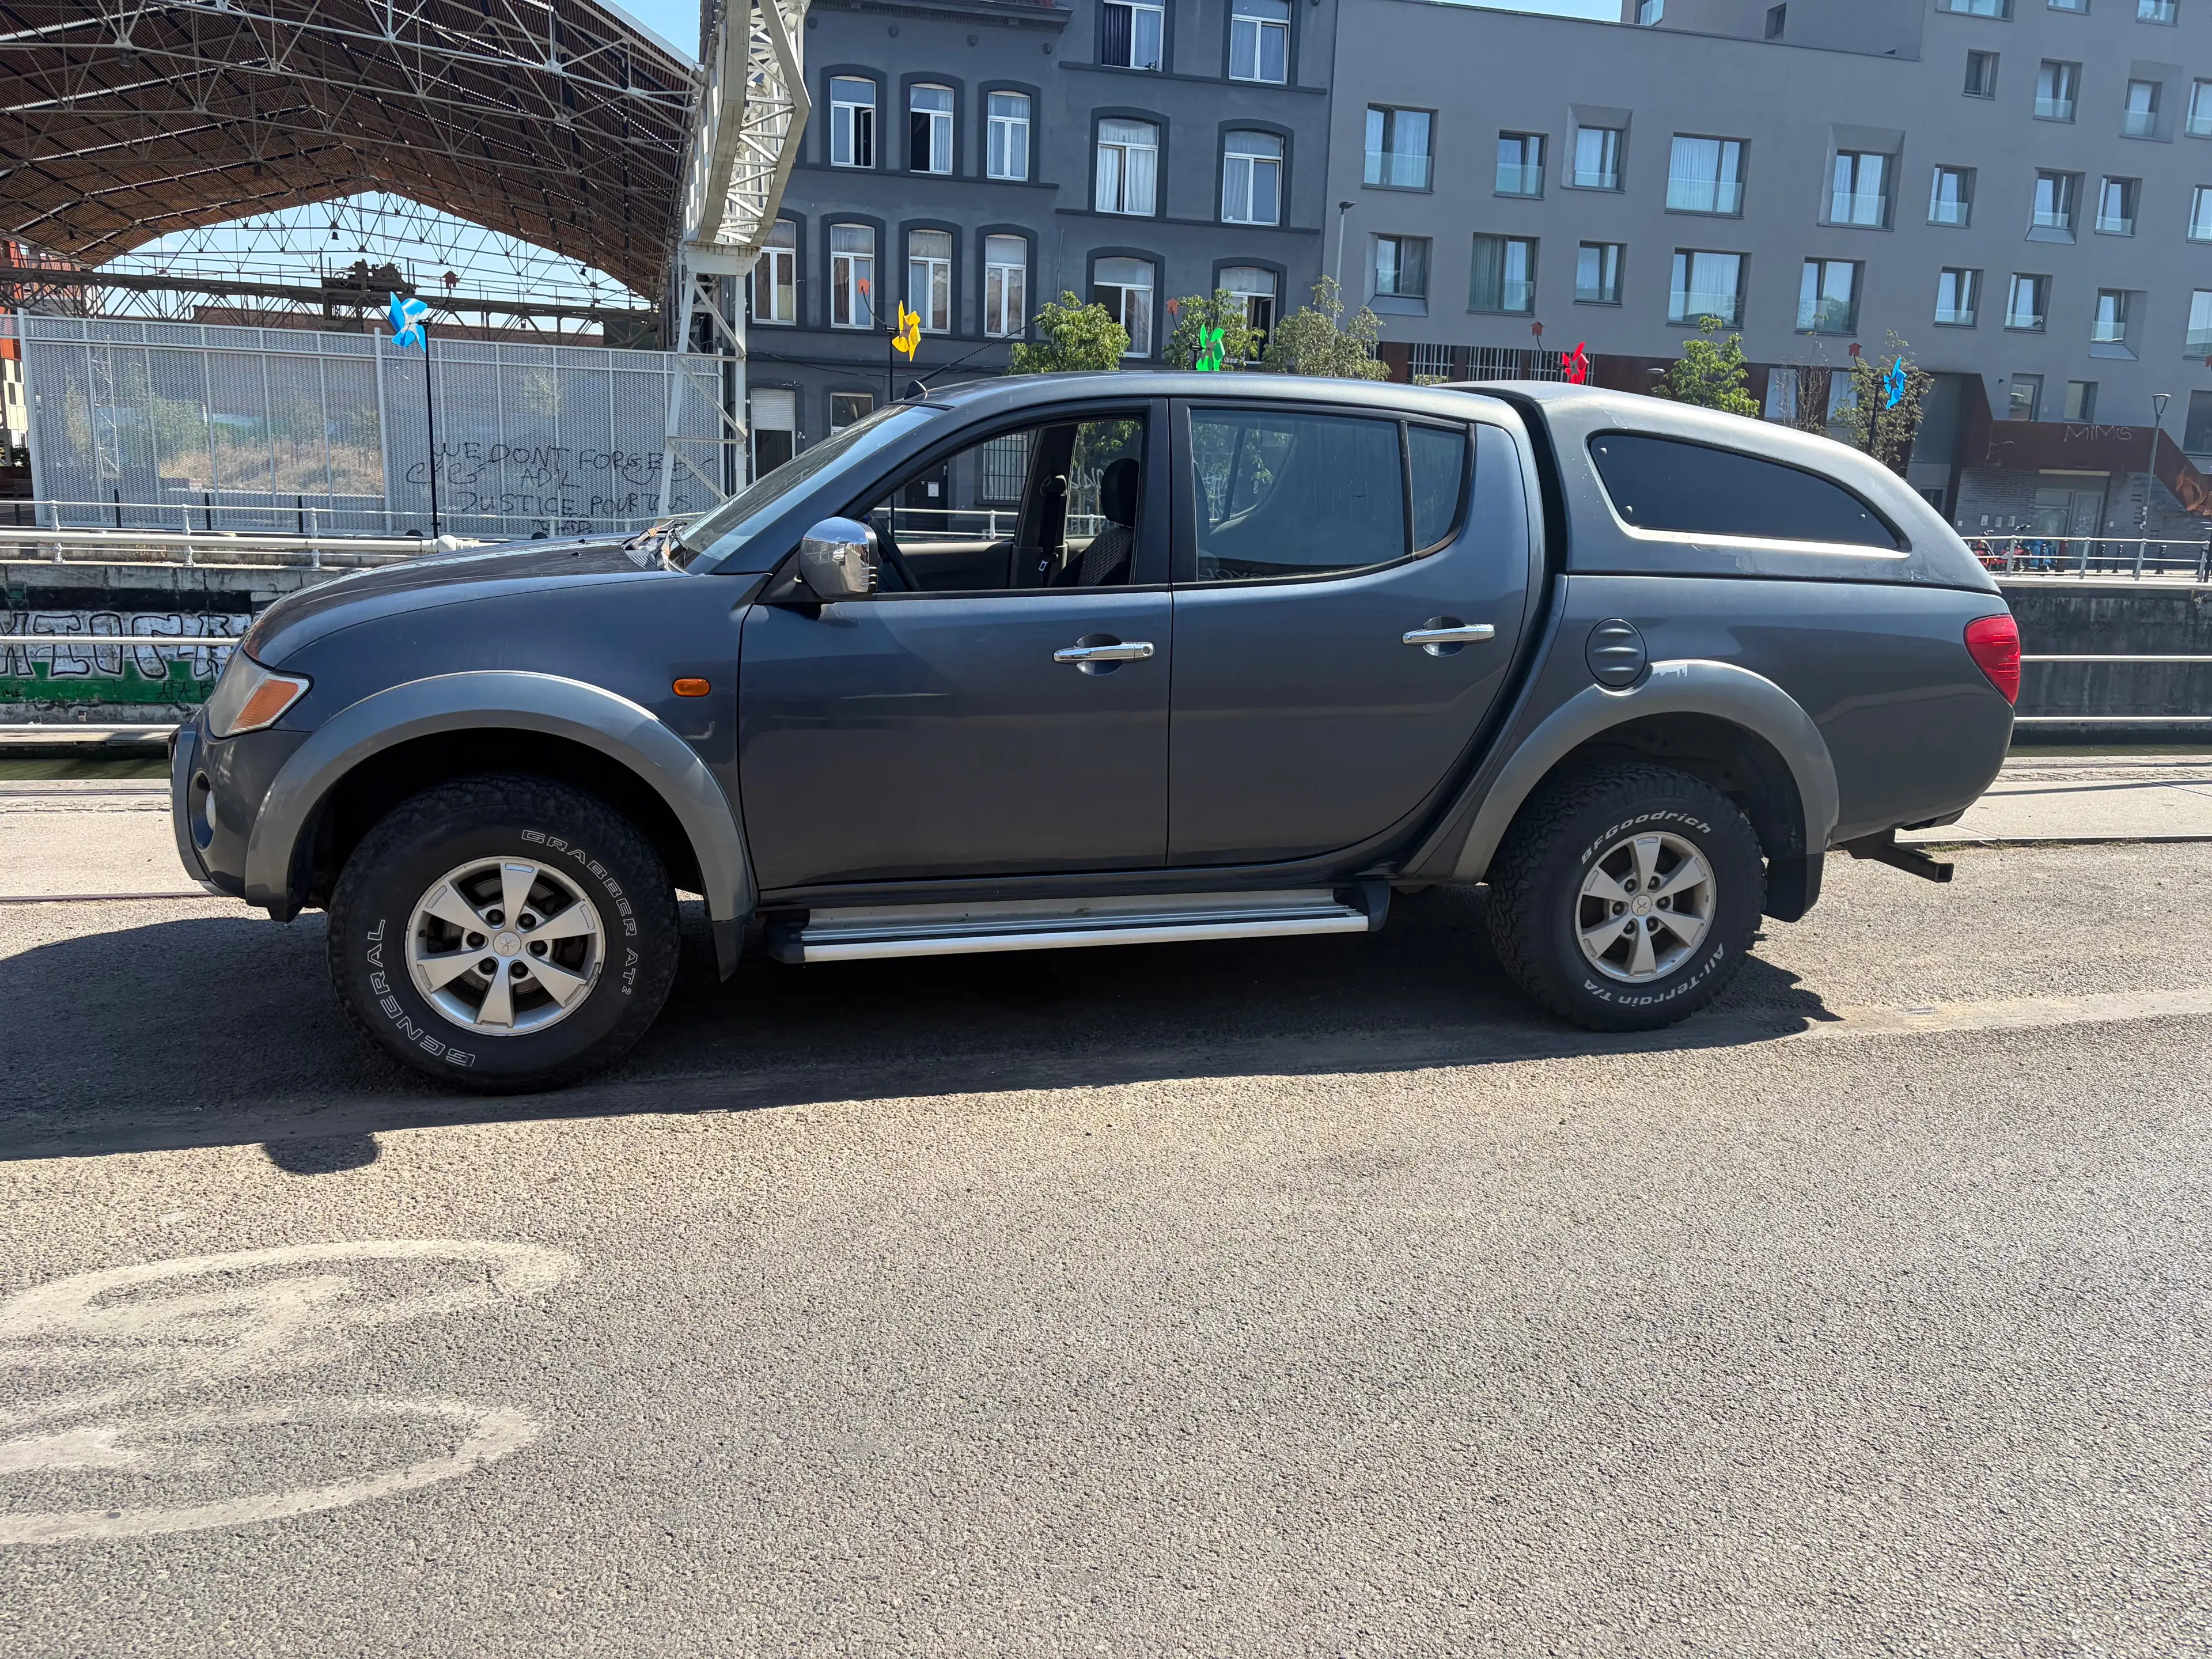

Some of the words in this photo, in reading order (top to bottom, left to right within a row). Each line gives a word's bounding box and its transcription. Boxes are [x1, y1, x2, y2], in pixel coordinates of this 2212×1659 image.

[591, 493, 638, 516] POUR
[1581, 810, 1711, 865] BFGoodrich
[521, 830, 637, 937] GRABBER
[367, 919, 476, 1067] GENERAL
[1584, 979, 1611, 1002] T/A
[1618, 942, 1724, 1007] All-Terrain
